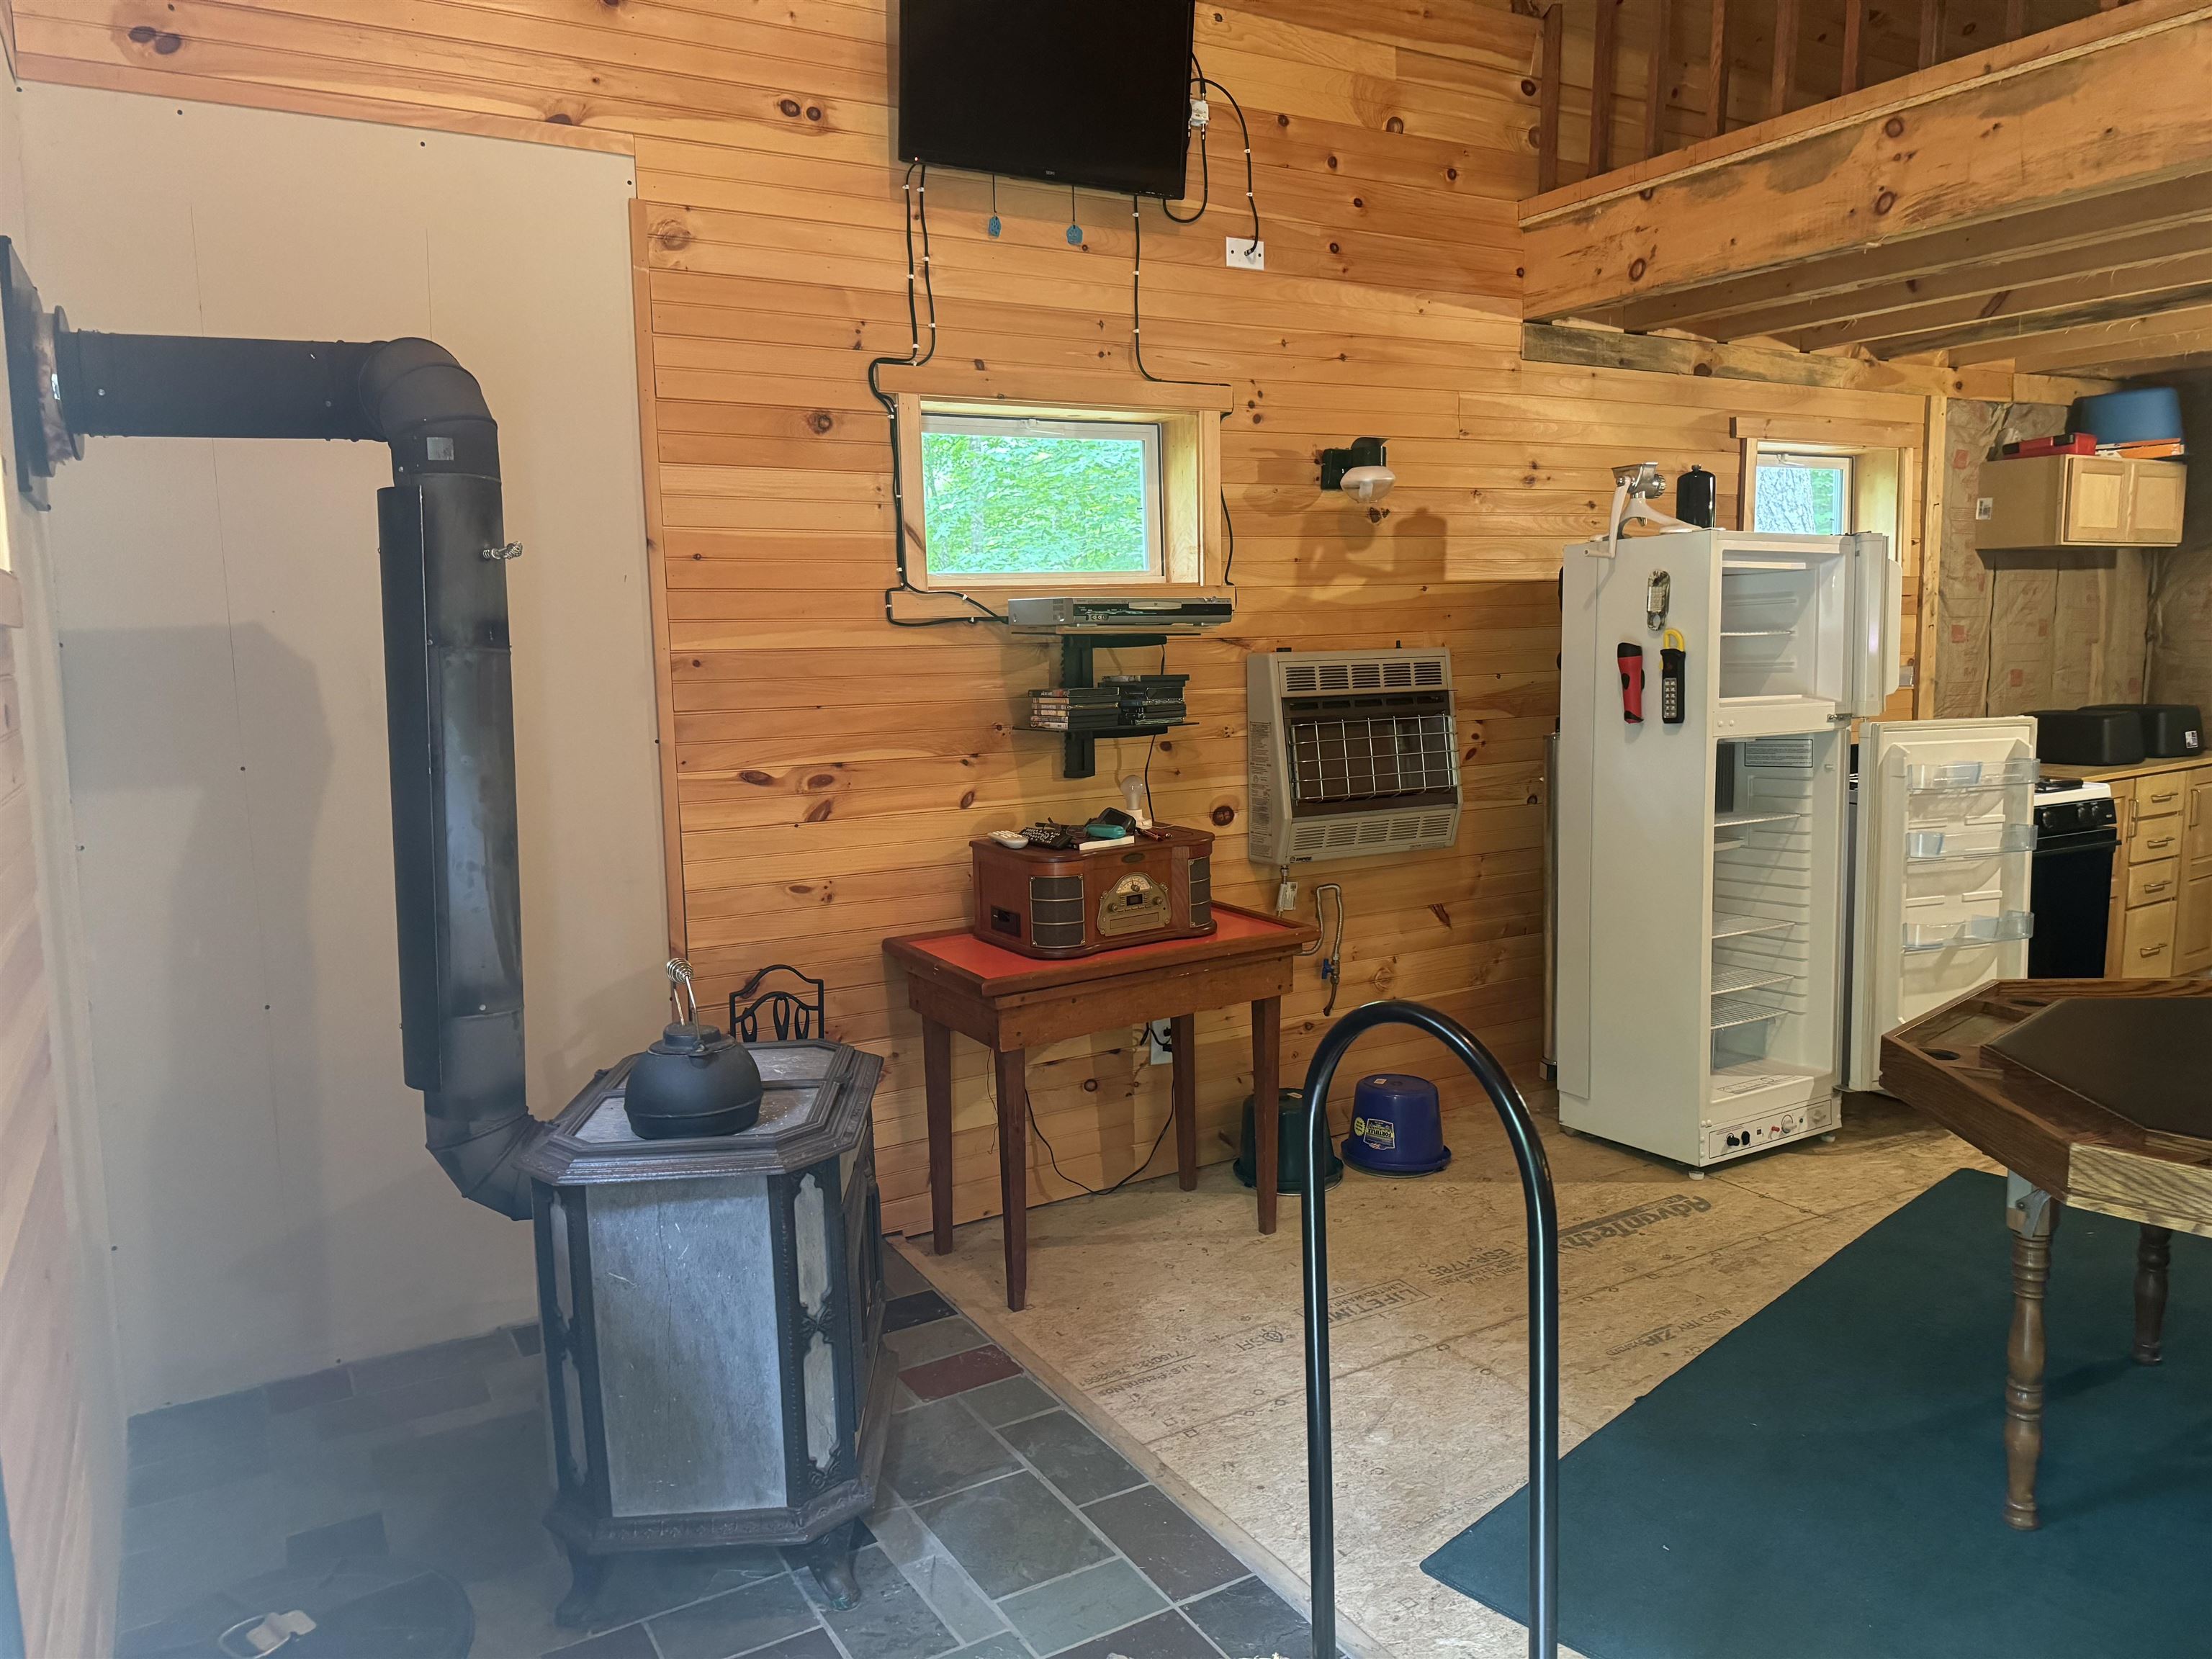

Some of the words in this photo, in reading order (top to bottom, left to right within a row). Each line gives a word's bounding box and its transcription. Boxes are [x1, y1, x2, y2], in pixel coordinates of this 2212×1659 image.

[1565, 1195, 1712, 1249] AdvanTech
[1427, 1248, 1512, 1277] ESR-1785
[1364, 1282, 1404, 1297] LIMITED
[1700, 1308, 1732, 1323] ALSO
[1677, 1318, 1701, 1332] TRY
